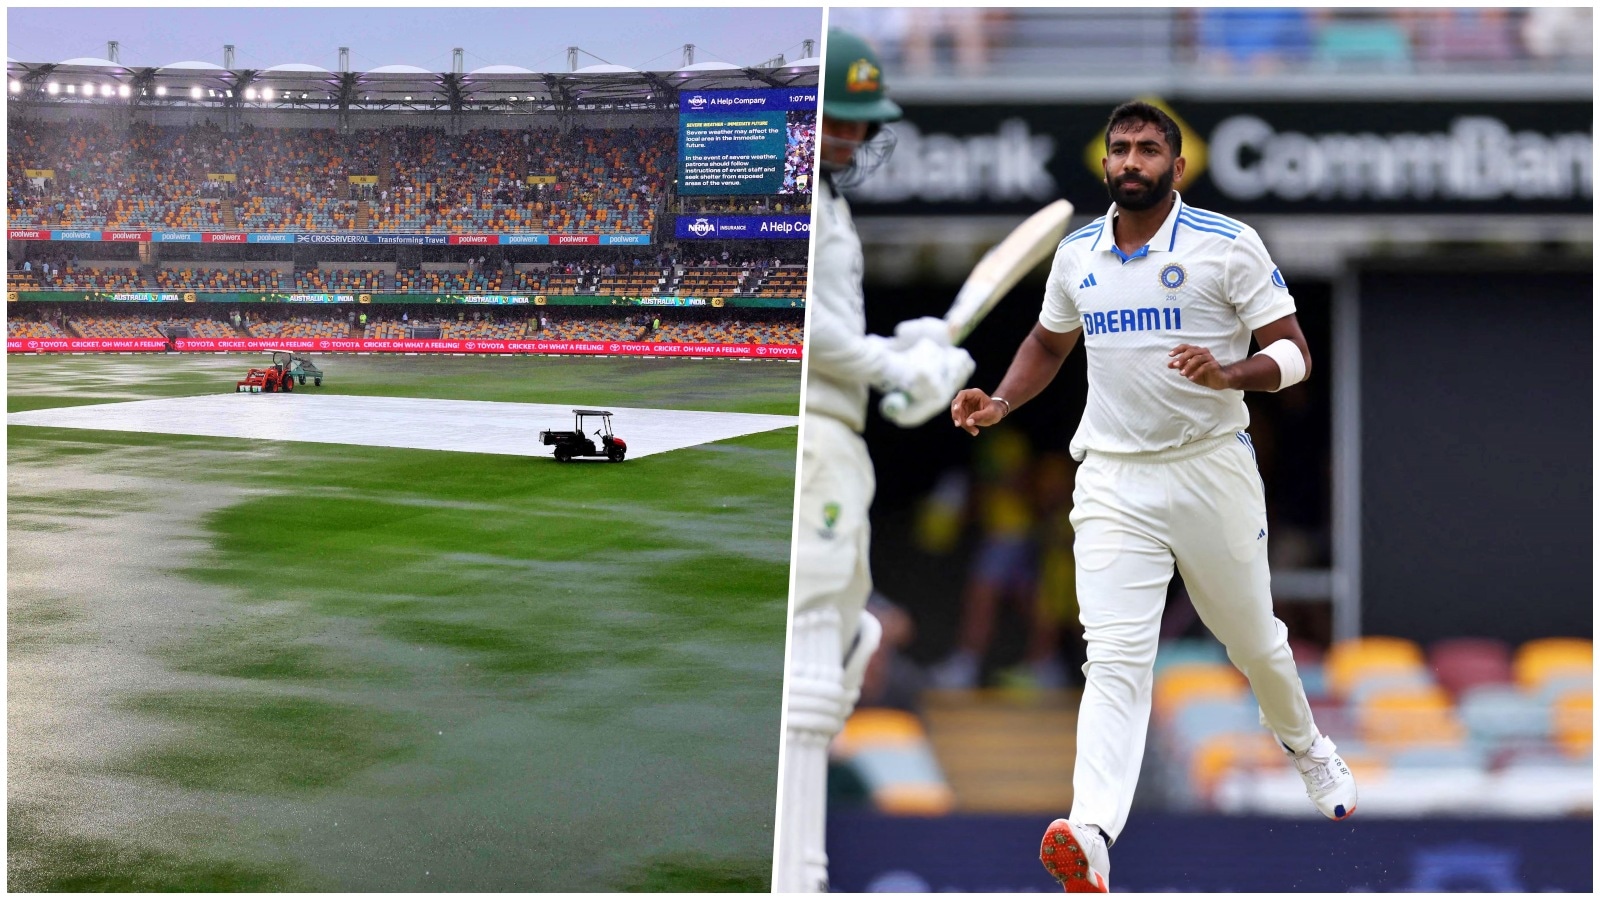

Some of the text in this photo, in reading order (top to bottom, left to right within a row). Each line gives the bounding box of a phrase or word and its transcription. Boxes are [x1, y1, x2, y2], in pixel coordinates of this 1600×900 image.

[717, 97, 733, 106] Help
[734, 97, 766, 105] Company
[789, 95, 803, 103] 1:07
[688, 224, 716, 232] NRMA
[760, 222, 768, 232] A
[769, 221, 792, 234] Help
[794, 221, 811, 232] Co
[10, 231, 39, 240] poolwerx
[61, 231, 91, 239] poolwerx
[112, 232, 141, 240] poolwerx
[162, 232, 191, 240] poolwerx
[212, 233, 241, 241] poolwerx
[257, 234, 286, 242] poolwerx
[458, 235, 487, 243] poolwerx
[509, 235, 538, 243] poolwerx
[559, 235, 588, 243] poolwerx
[609, 235, 639, 243] poolwerx
[378, 236, 423, 244] Transforming
[425, 236, 446, 244] Travel
[1083, 307, 1182, 336] DREAM11
